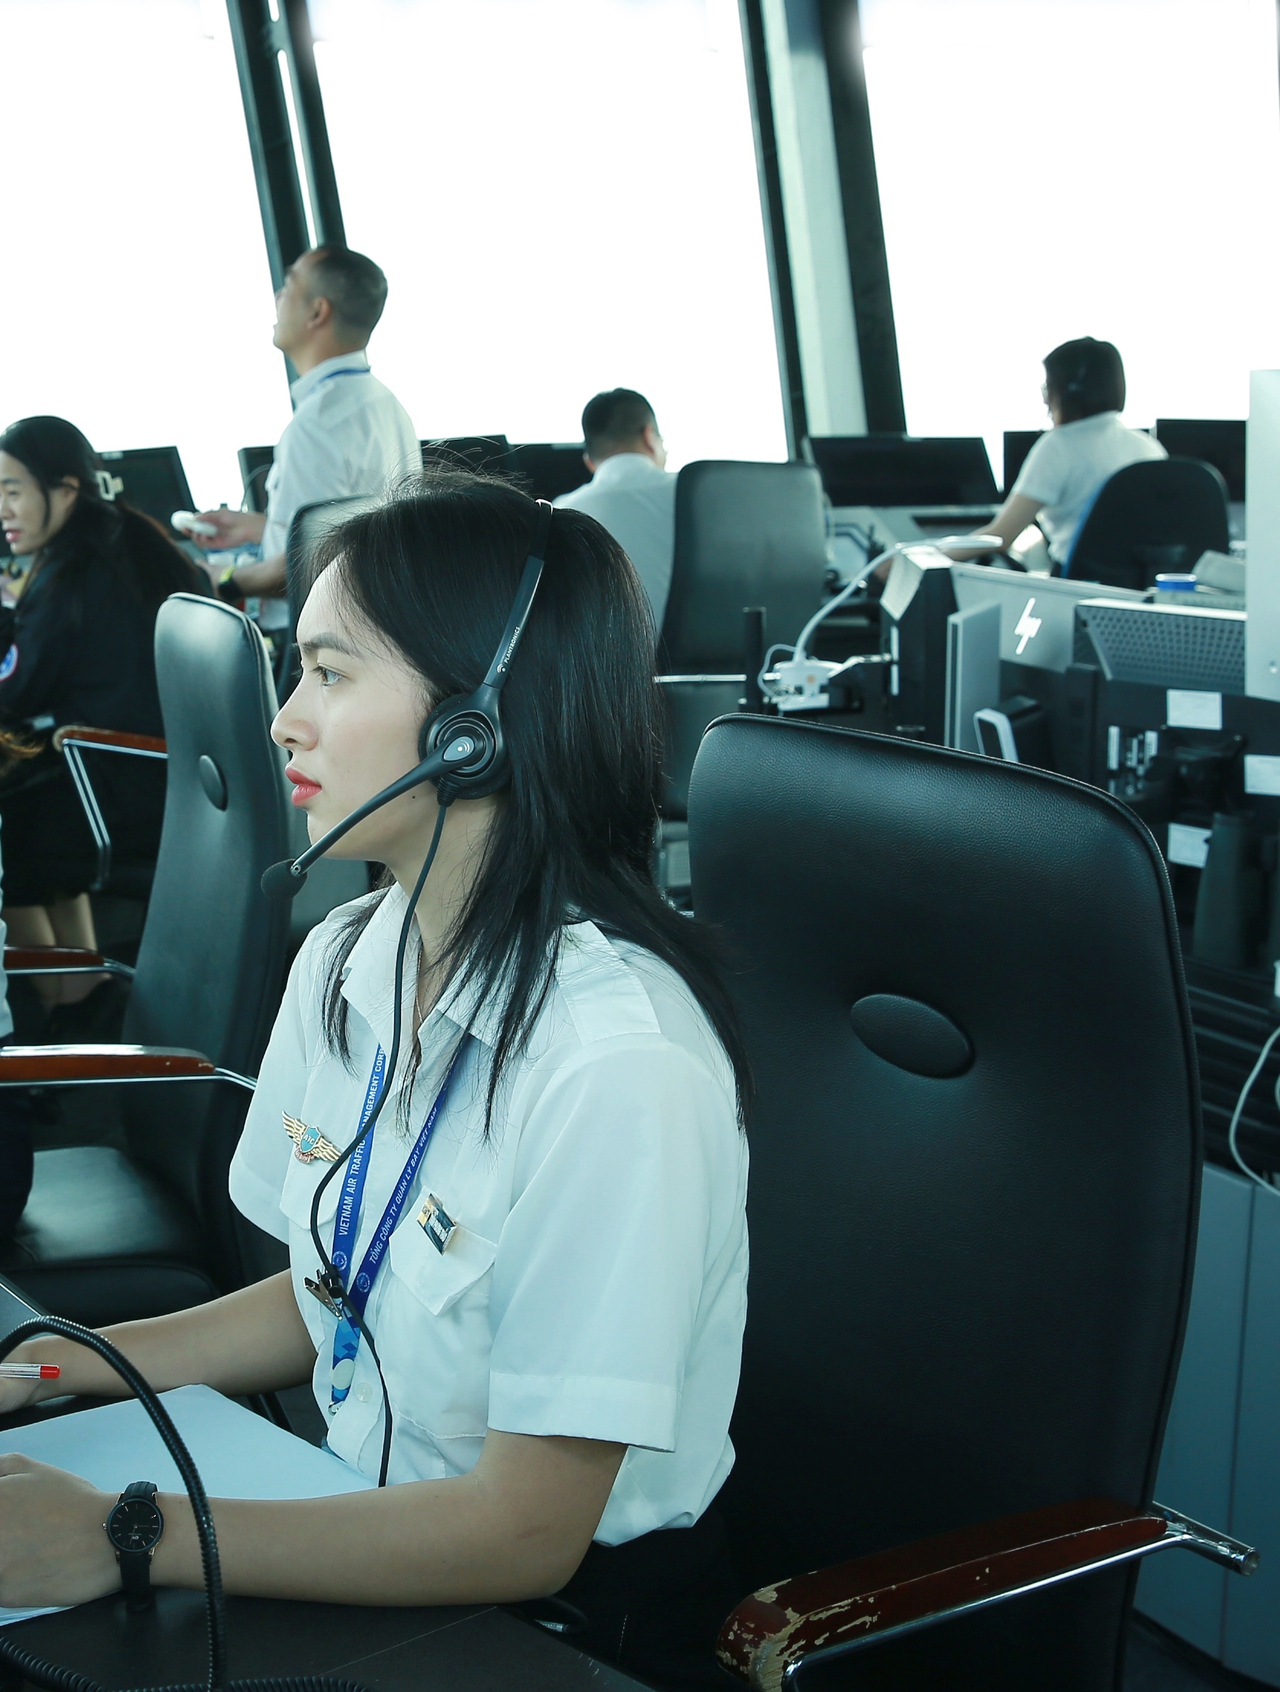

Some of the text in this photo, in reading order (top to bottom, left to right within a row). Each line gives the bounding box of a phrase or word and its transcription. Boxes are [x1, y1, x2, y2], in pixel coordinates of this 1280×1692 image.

[503, 626, 520, 664] PLANTRONICS
[361, 1075, 380, 1134] NAGEMENT
[303, 1134, 315, 1145] ATC
[390, 1204, 398, 1217] TY
[411, 1147, 420, 1167] BAY
[428, 1107, 438, 1128] NAM
[346, 1178, 357, 1194] AIR
[339, 1197, 354, 1236] VIETNAM
